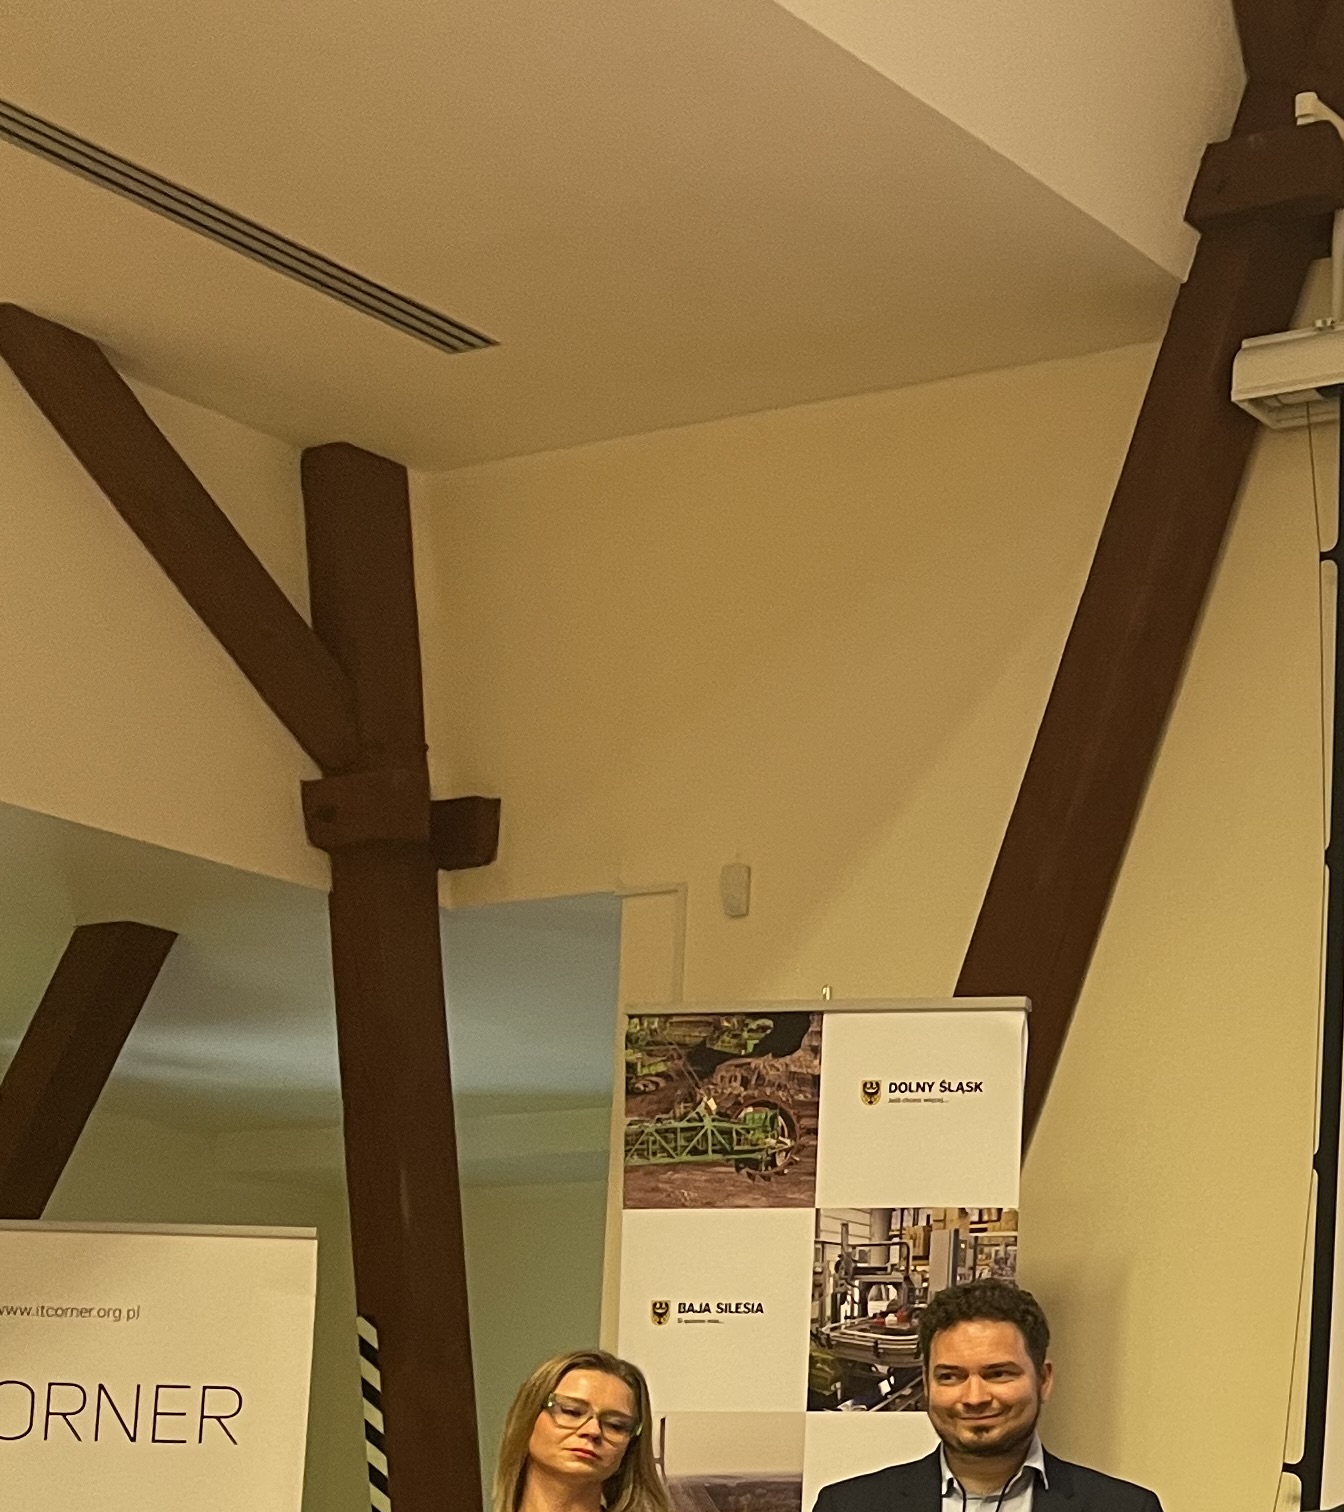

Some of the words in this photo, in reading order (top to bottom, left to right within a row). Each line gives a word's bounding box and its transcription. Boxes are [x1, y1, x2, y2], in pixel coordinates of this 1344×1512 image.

[888, 1081, 935, 1093] DOLNY
[939, 1079, 983, 1095] ŚLĄSK
[677, 1302, 712, 1313] BAJA
[715, 1302, 764, 1314] SILESIA
[0, 1379, 243, 1445] ORNER
